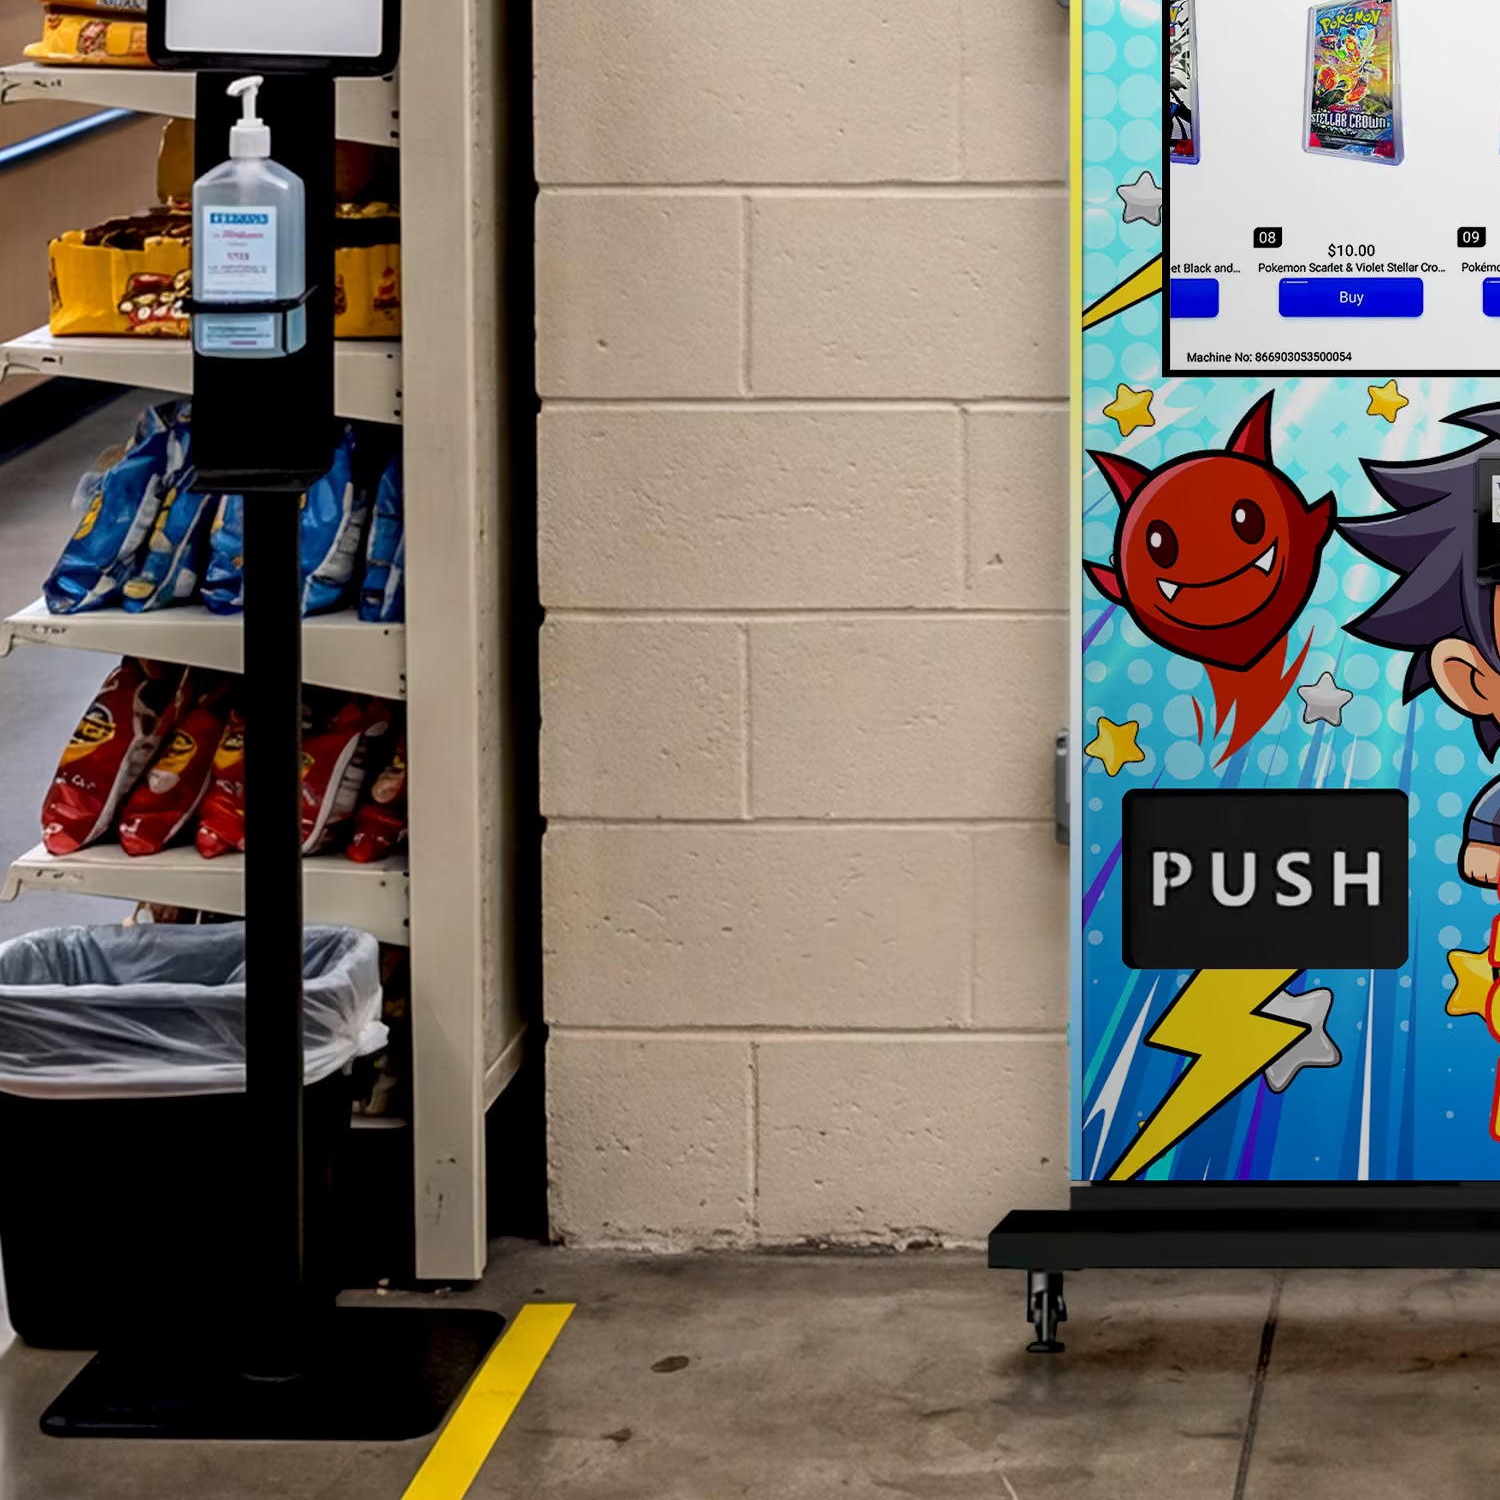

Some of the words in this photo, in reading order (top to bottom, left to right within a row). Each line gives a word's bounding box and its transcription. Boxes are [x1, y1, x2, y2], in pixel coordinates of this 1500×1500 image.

[1311, 112, 1347, 128] STELLAR
[1259, 231, 1276, 244] 08
[1462, 231, 1480, 244] 09
[1327, 243, 1376, 258] $10.00
[1183, 263, 1212, 273] Black
[1214, 263, 1241, 273] and...
[1258, 263, 1307, 273] Pokemon
[1308, 263, 1343, 273] Scarlet
[1345, 263, 1354, 273] &
[1355, 263, 1385, 273] Violet
[1387, 263, 1419, 273] Stellar
[1420, 263, 1446, 273] Cro...
[1339, 290, 1364, 306] Buy
[1186, 352, 1231, 362] Machine
[1234, 352, 1252, 362] No:
[1255, 351, 1353, 362] 866903053500054
[1151, 849, 1381, 907] PUSH
